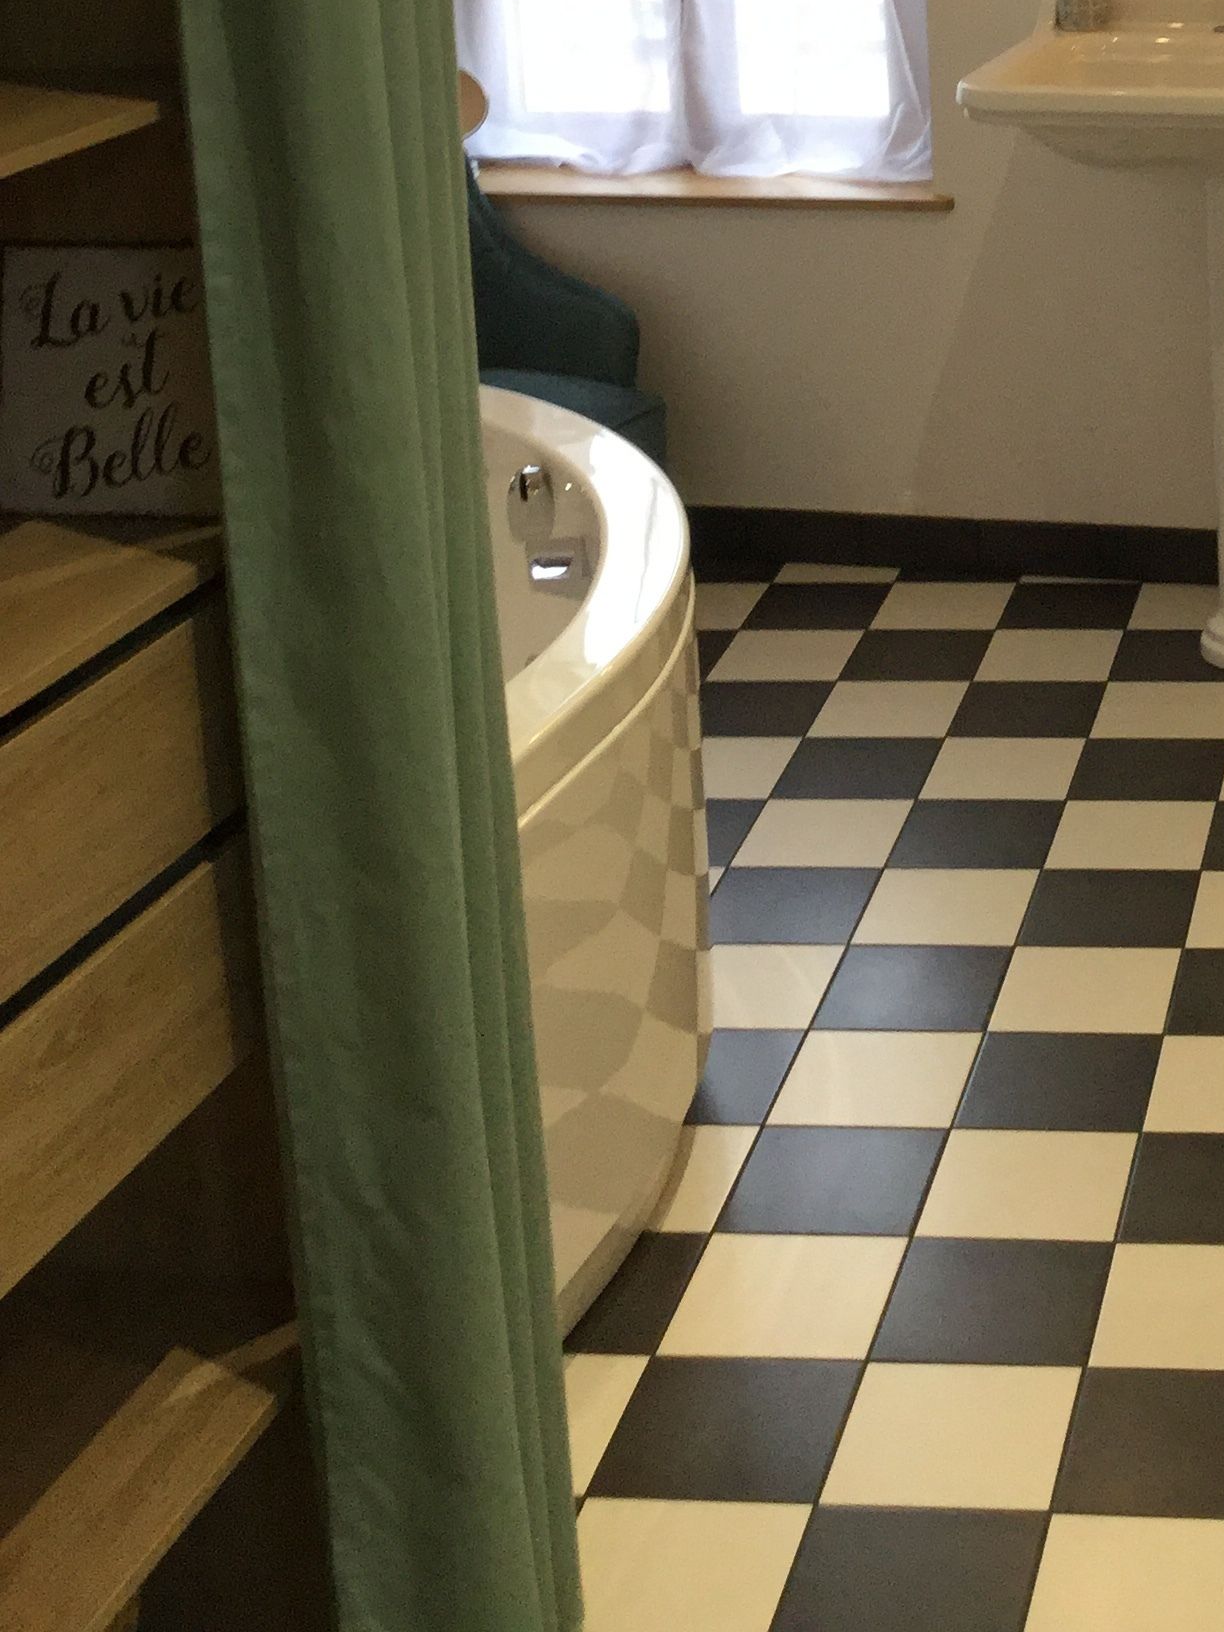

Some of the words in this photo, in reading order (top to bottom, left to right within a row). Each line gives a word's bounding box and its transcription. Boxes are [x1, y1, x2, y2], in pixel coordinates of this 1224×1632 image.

[19, 272, 110, 348] La
[119, 272, 200, 322] vie
[85, 329, 169, 408] est
[31, 401, 210, 498] Belle
